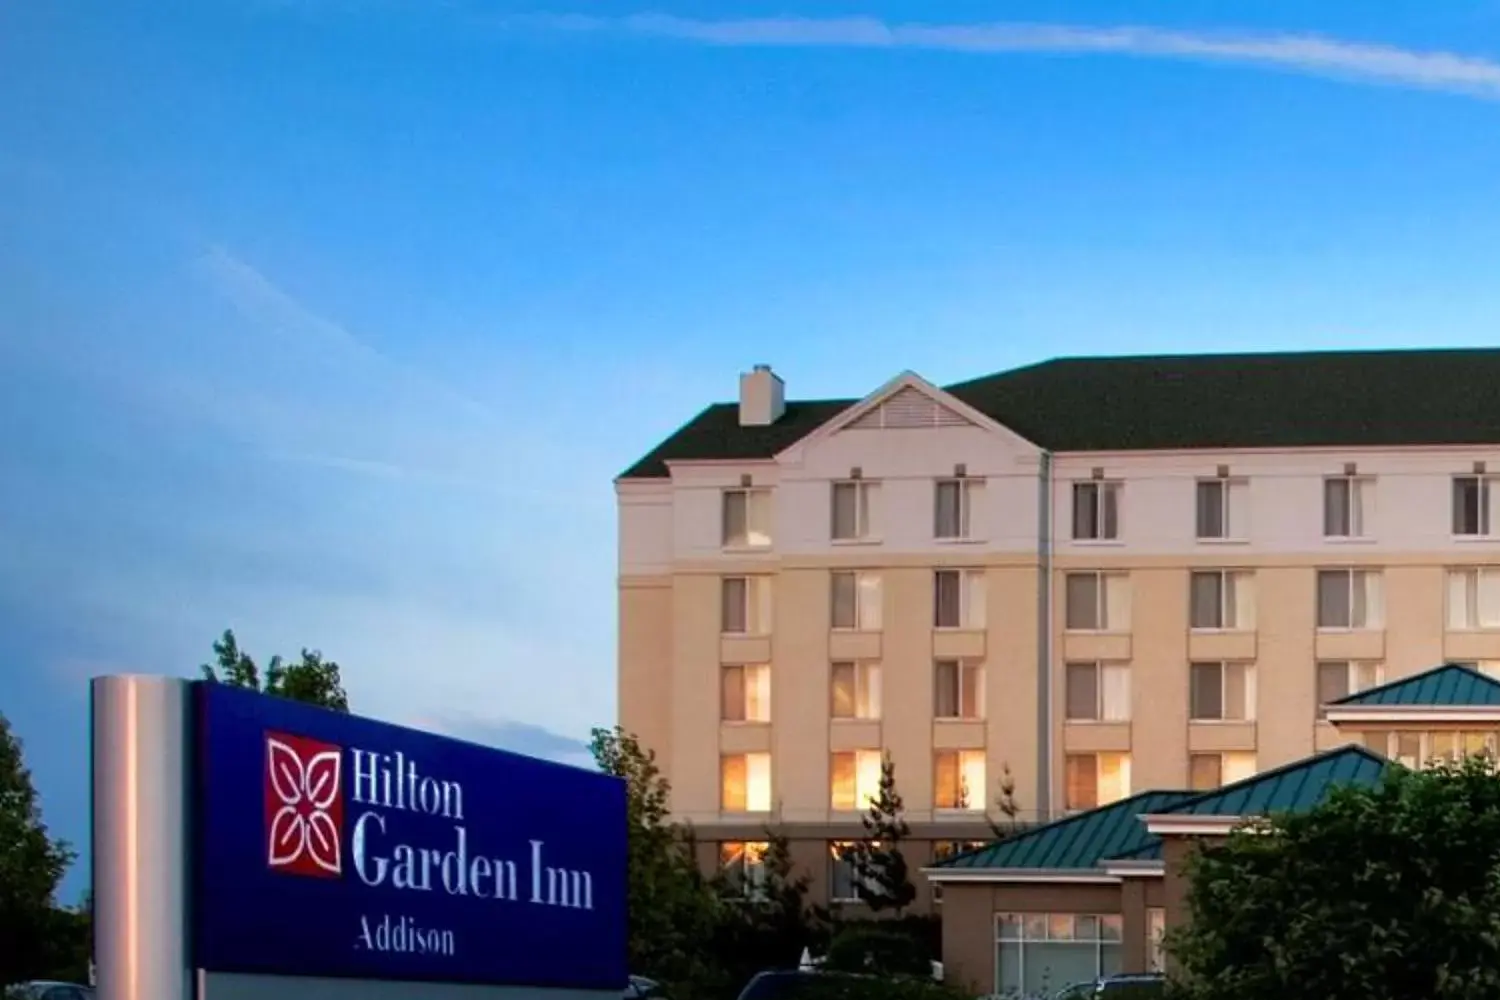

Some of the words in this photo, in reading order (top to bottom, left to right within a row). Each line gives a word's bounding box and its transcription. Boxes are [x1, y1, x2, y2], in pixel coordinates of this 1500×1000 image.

[350, 747, 464, 819] Hilton
[352, 811, 517, 901] Garden
[528, 839, 594, 910] Inn
[353, 914, 455, 956] Addison
